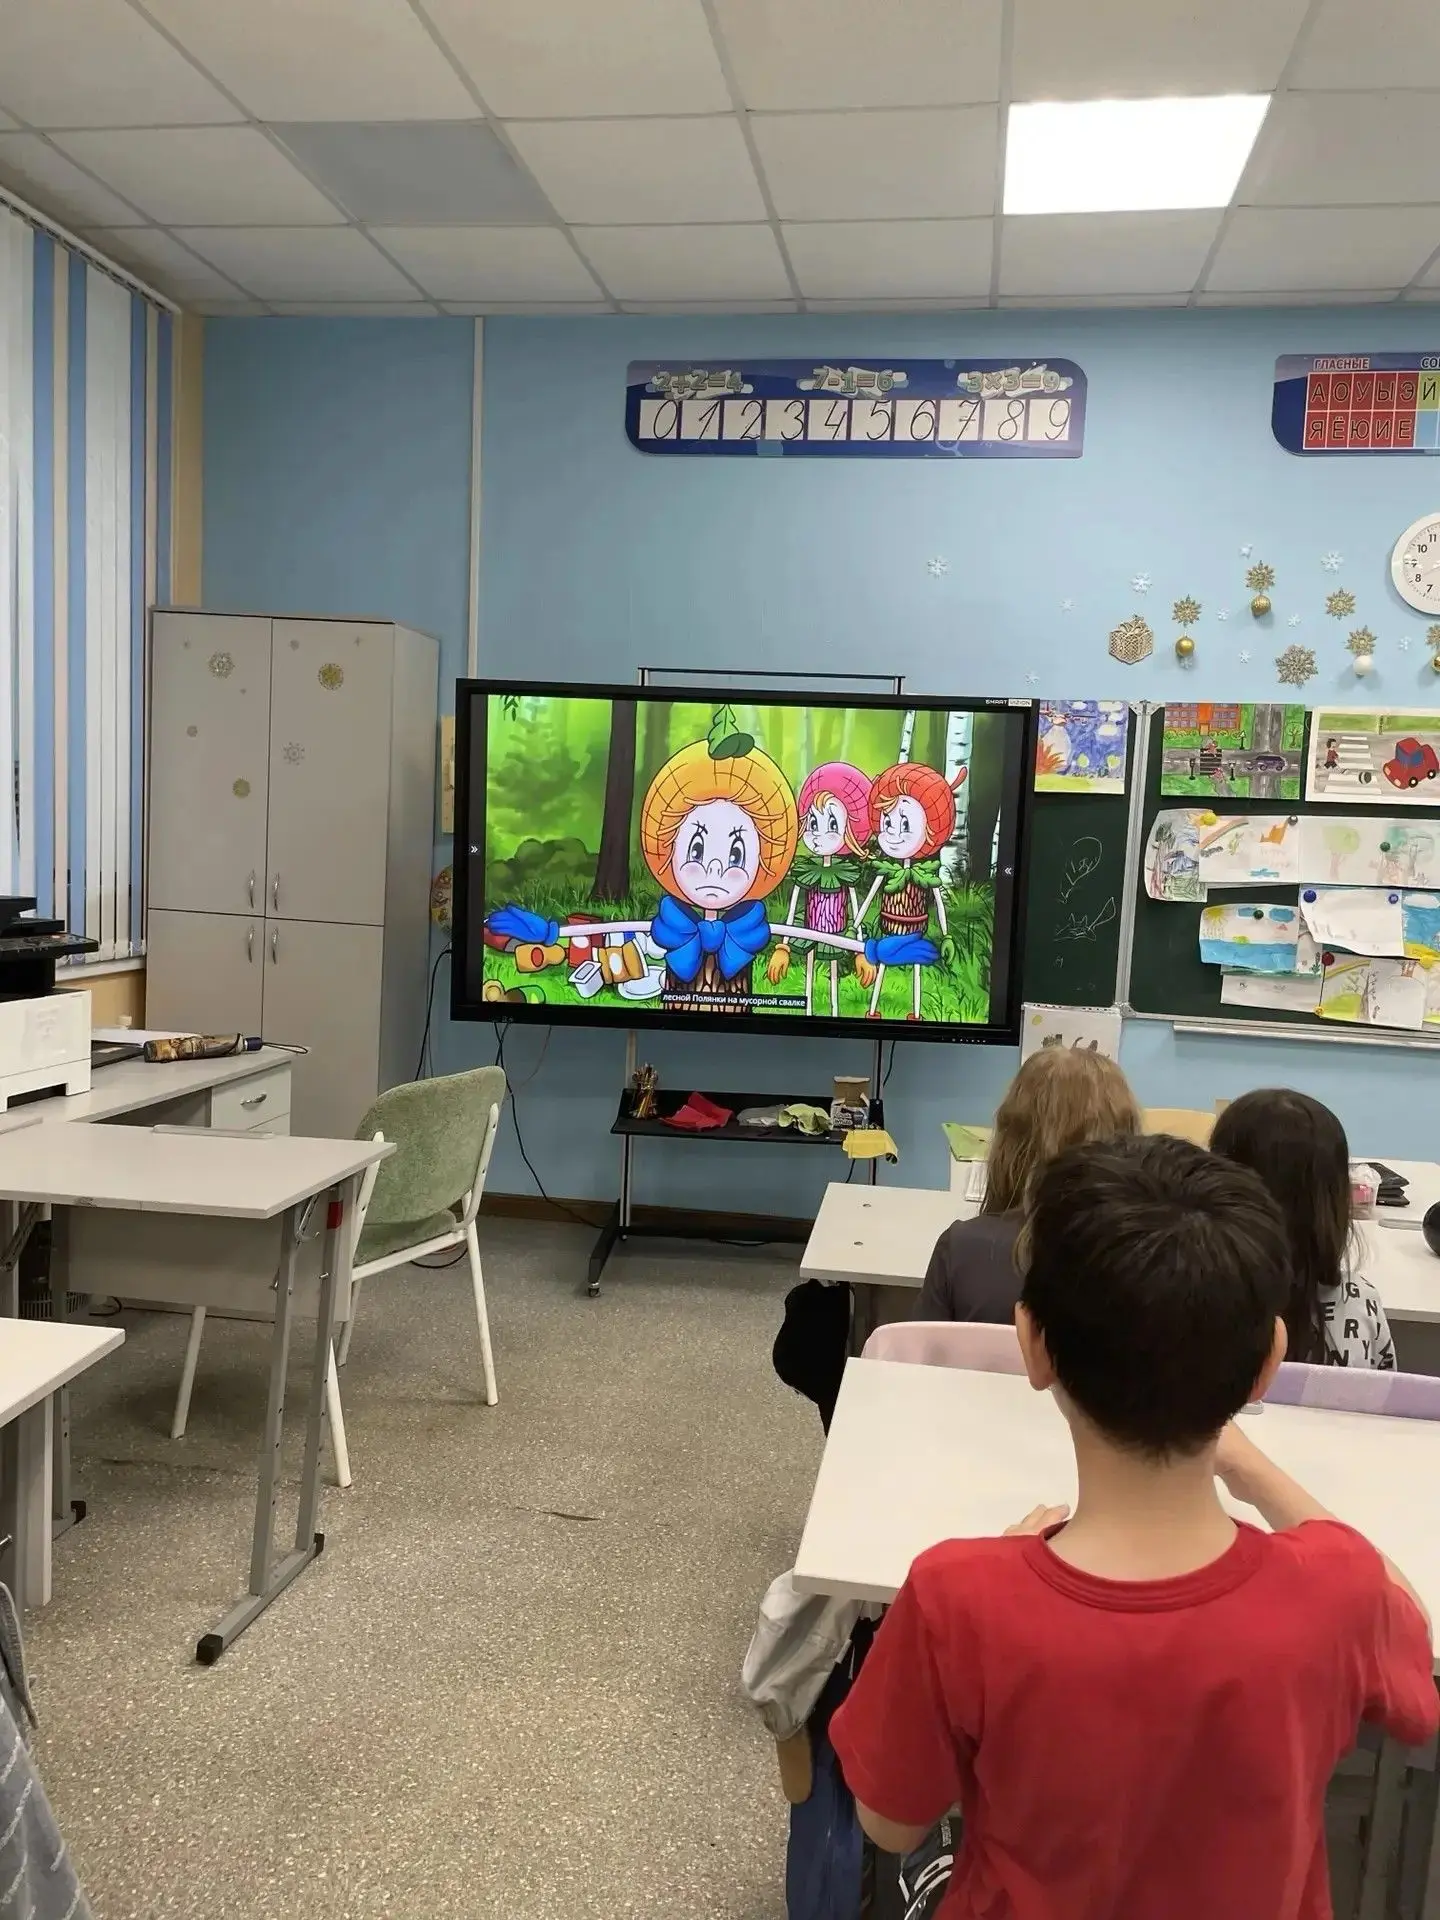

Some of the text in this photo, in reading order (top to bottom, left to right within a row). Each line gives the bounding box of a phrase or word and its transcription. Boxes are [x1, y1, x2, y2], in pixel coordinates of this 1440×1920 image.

[1314, 358, 1370, 370] ГЛАСНЫЕ
[1421, 357, 1440, 369] СО
[1423, 377, 1437, 401] Й
[653, 399, 1070, 440] 0 1 2 3 4 5 6 7 8 9
[1429, 534, 1437, 543] 11
[1417, 544, 1428, 553] 10
[1415, 573, 1422, 583] 8
[1426, 584, 1434, 593] 7
[662, 993, 691, 1002] лесной
[692, 994, 727, 1003] Полянки
[739, 997, 778, 1007] мусорной
[778, 999, 806, 1007] свалке
